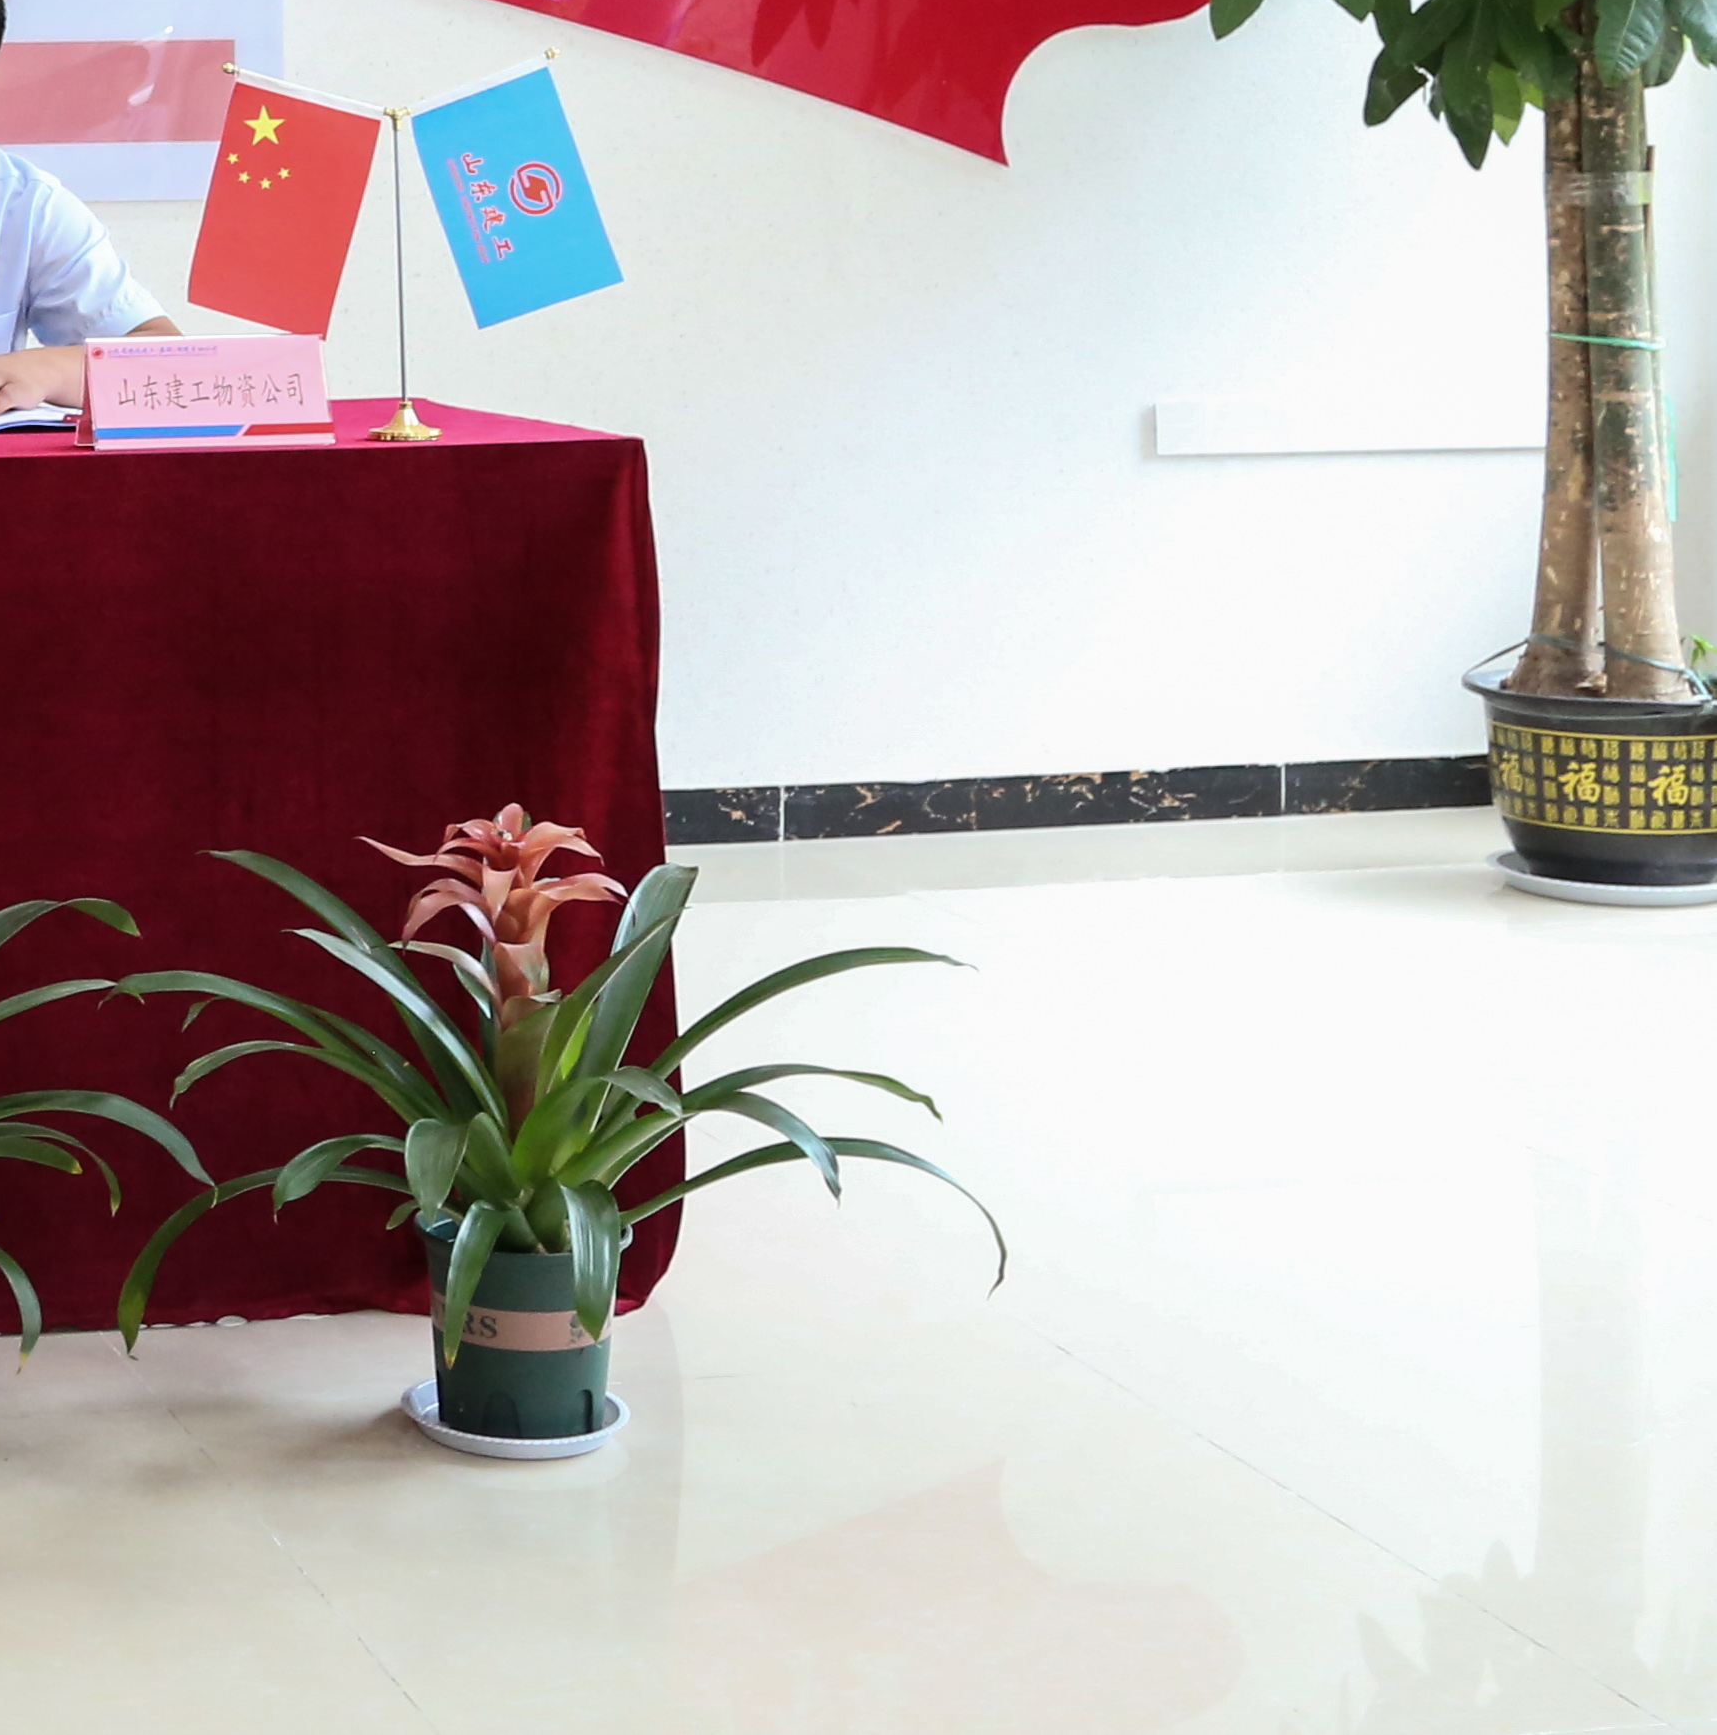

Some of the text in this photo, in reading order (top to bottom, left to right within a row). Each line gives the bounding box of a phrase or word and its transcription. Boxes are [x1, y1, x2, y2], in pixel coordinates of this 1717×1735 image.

[461, 153, 513, 258] 山东建工
[119, 373, 304, 411] 山东建工物资公司
[1499, 751, 1689, 806] 福 福 福
